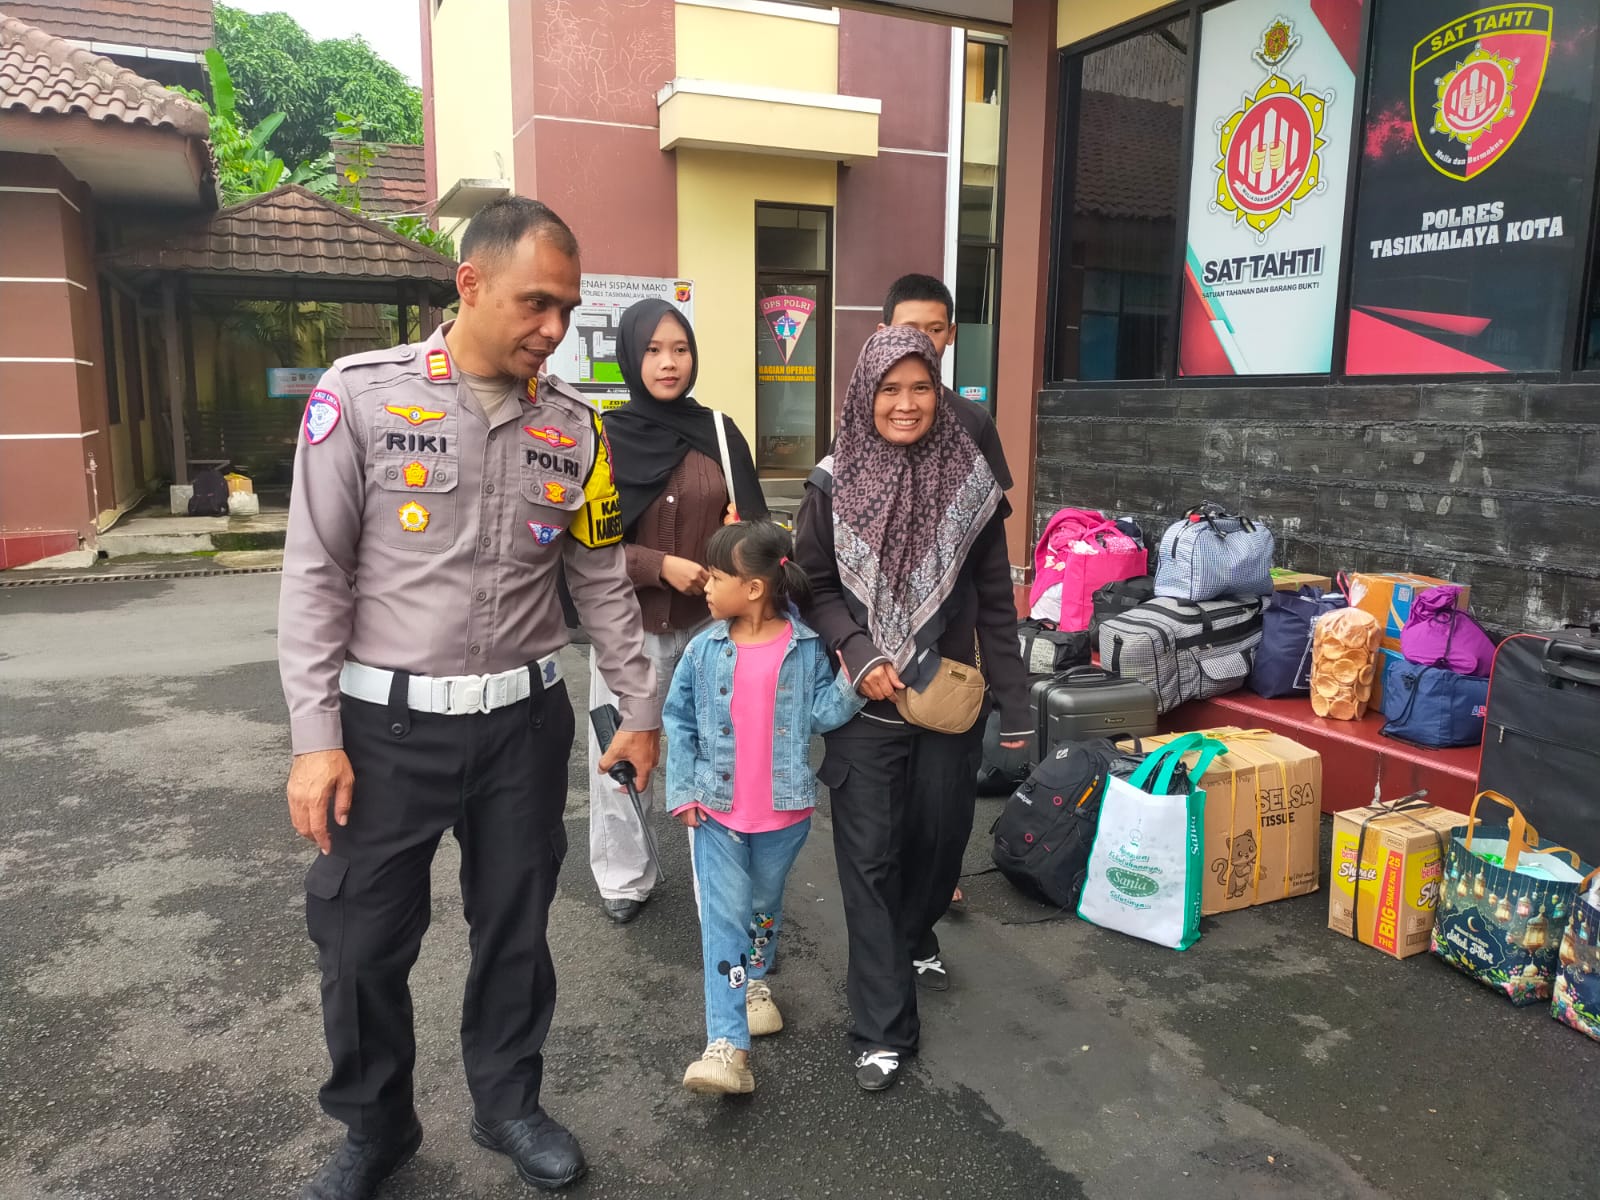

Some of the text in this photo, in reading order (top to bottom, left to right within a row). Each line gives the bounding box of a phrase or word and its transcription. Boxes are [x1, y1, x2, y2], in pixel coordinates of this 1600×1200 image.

[1431, 10, 1533, 52] SAT TAHTI
[1421, 201, 1504, 231] POLRES
[1370, 215, 1564, 259] TASIKMALAYA KOTA
[1203, 247, 1322, 283] SAT TAHTI
[581, 280, 668, 292] ENAH SISPAM MAKO
[1202, 291, 1225, 299] SATUAN
[1225, 289, 1255, 297] TAHANAN
[1270, 284, 1297, 293] BARANG
[1298, 281, 1319, 290] BUKTI
[763, 299, 811, 310] OPS POLRI
[759, 365, 816, 375] BAGIAN OPERASI
[386, 432, 447, 453] RIKI
[526, 449, 579, 478] POLRI
[1255, 783, 1314, 814] SELSA
[1260, 812, 1295, 827] TISSUE
[1388, 855, 1401, 868] 25
[1113, 871, 1148, 890] Sania
[1385, 884, 1396, 908] SHARE
[1379, 907, 1396, 939] BIG
[1378, 935, 1393, 949] THE
